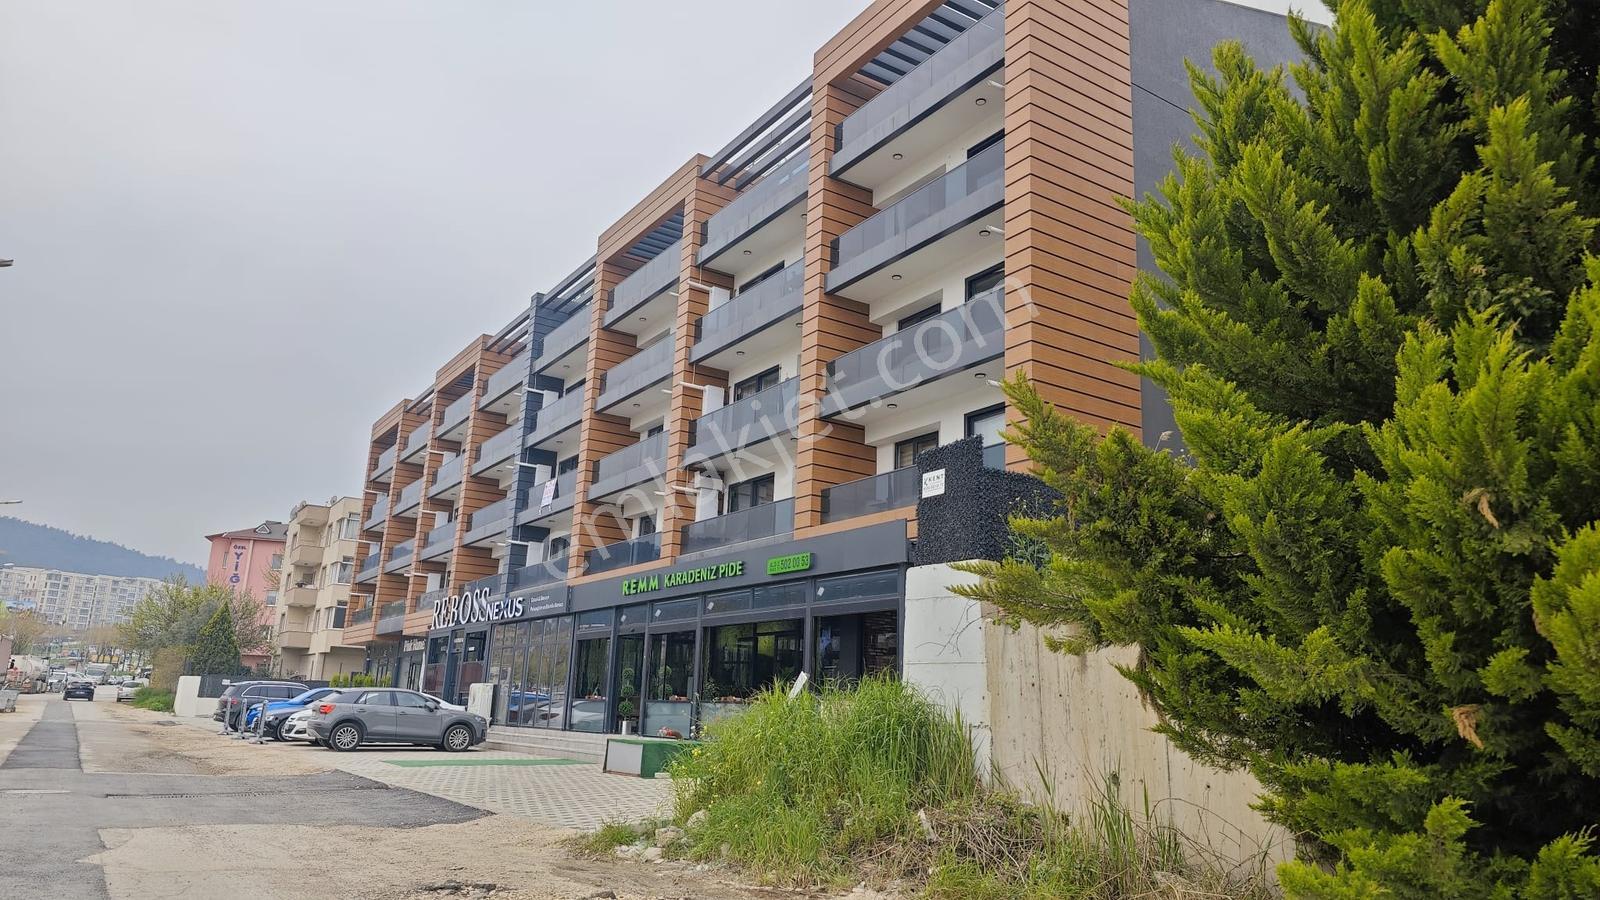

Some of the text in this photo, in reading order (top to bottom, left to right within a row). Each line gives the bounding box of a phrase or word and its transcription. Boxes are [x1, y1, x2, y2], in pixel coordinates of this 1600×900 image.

[622, 574, 660, 596] REMM
[431, 587, 524, 630] REBOSS NEXUS
